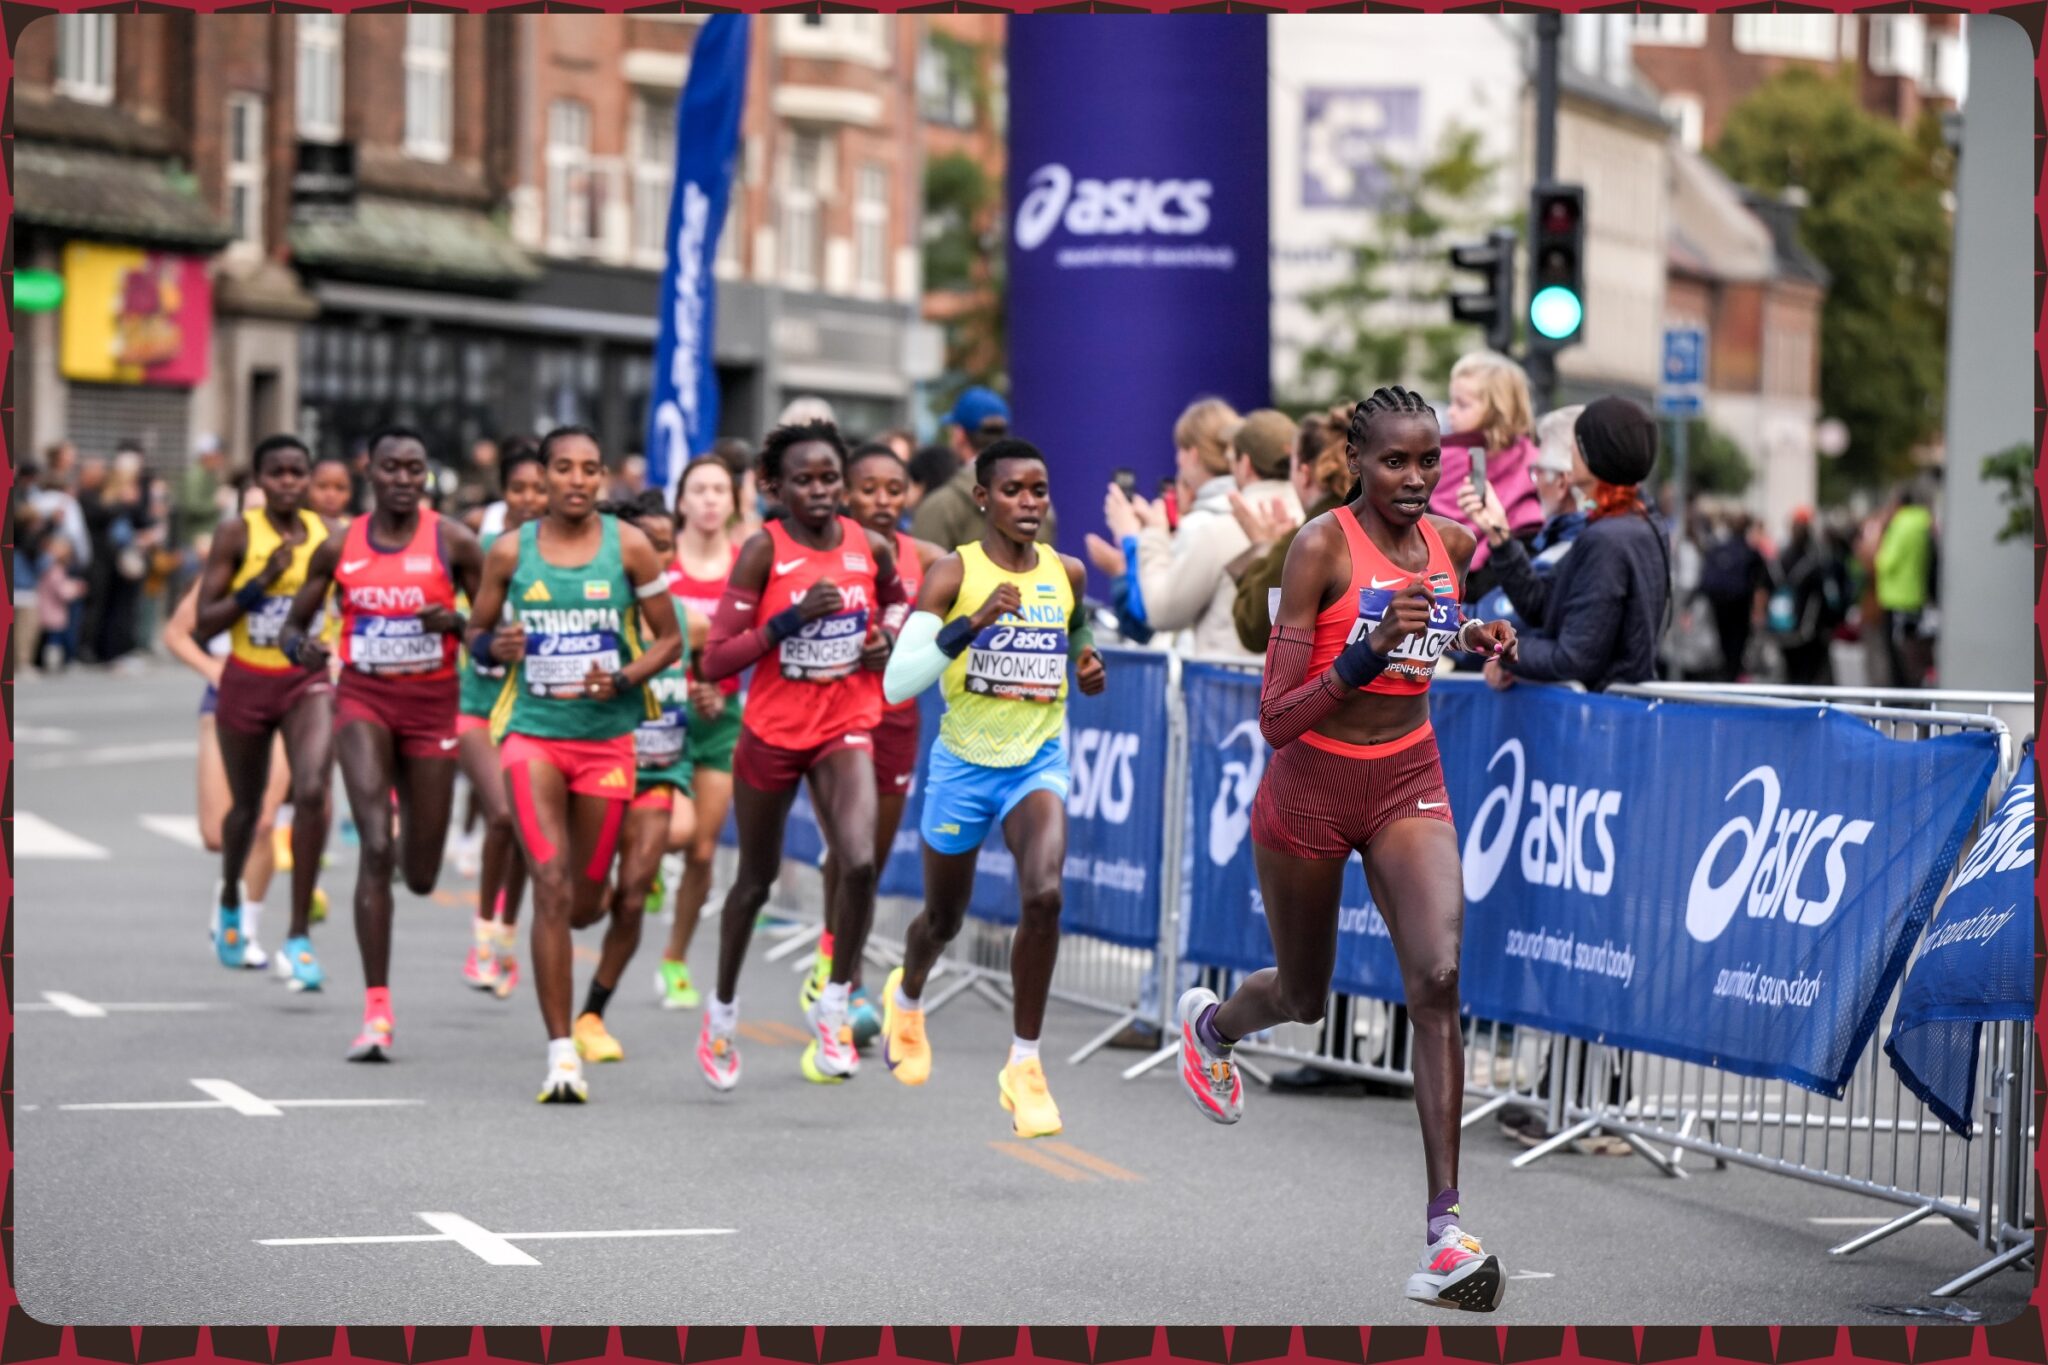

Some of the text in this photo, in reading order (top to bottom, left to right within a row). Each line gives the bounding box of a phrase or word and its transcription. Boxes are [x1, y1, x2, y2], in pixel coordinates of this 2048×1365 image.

[1064, 178, 1213, 235] asics
[350, 586, 425, 609] KENYA
[790, 586, 867, 608] KYA
[520, 607, 620, 634] ETHIOPIA
[357, 636, 437, 657] JERONO
[1012, 632, 1057, 650] asics
[1521, 779, 1622, 896] asics
[1747, 808, 1875, 927] asics
[1505, 925, 1546, 960] sound
[1574, 938, 1609, 974] sound
[1606, 940, 1636, 989] body
